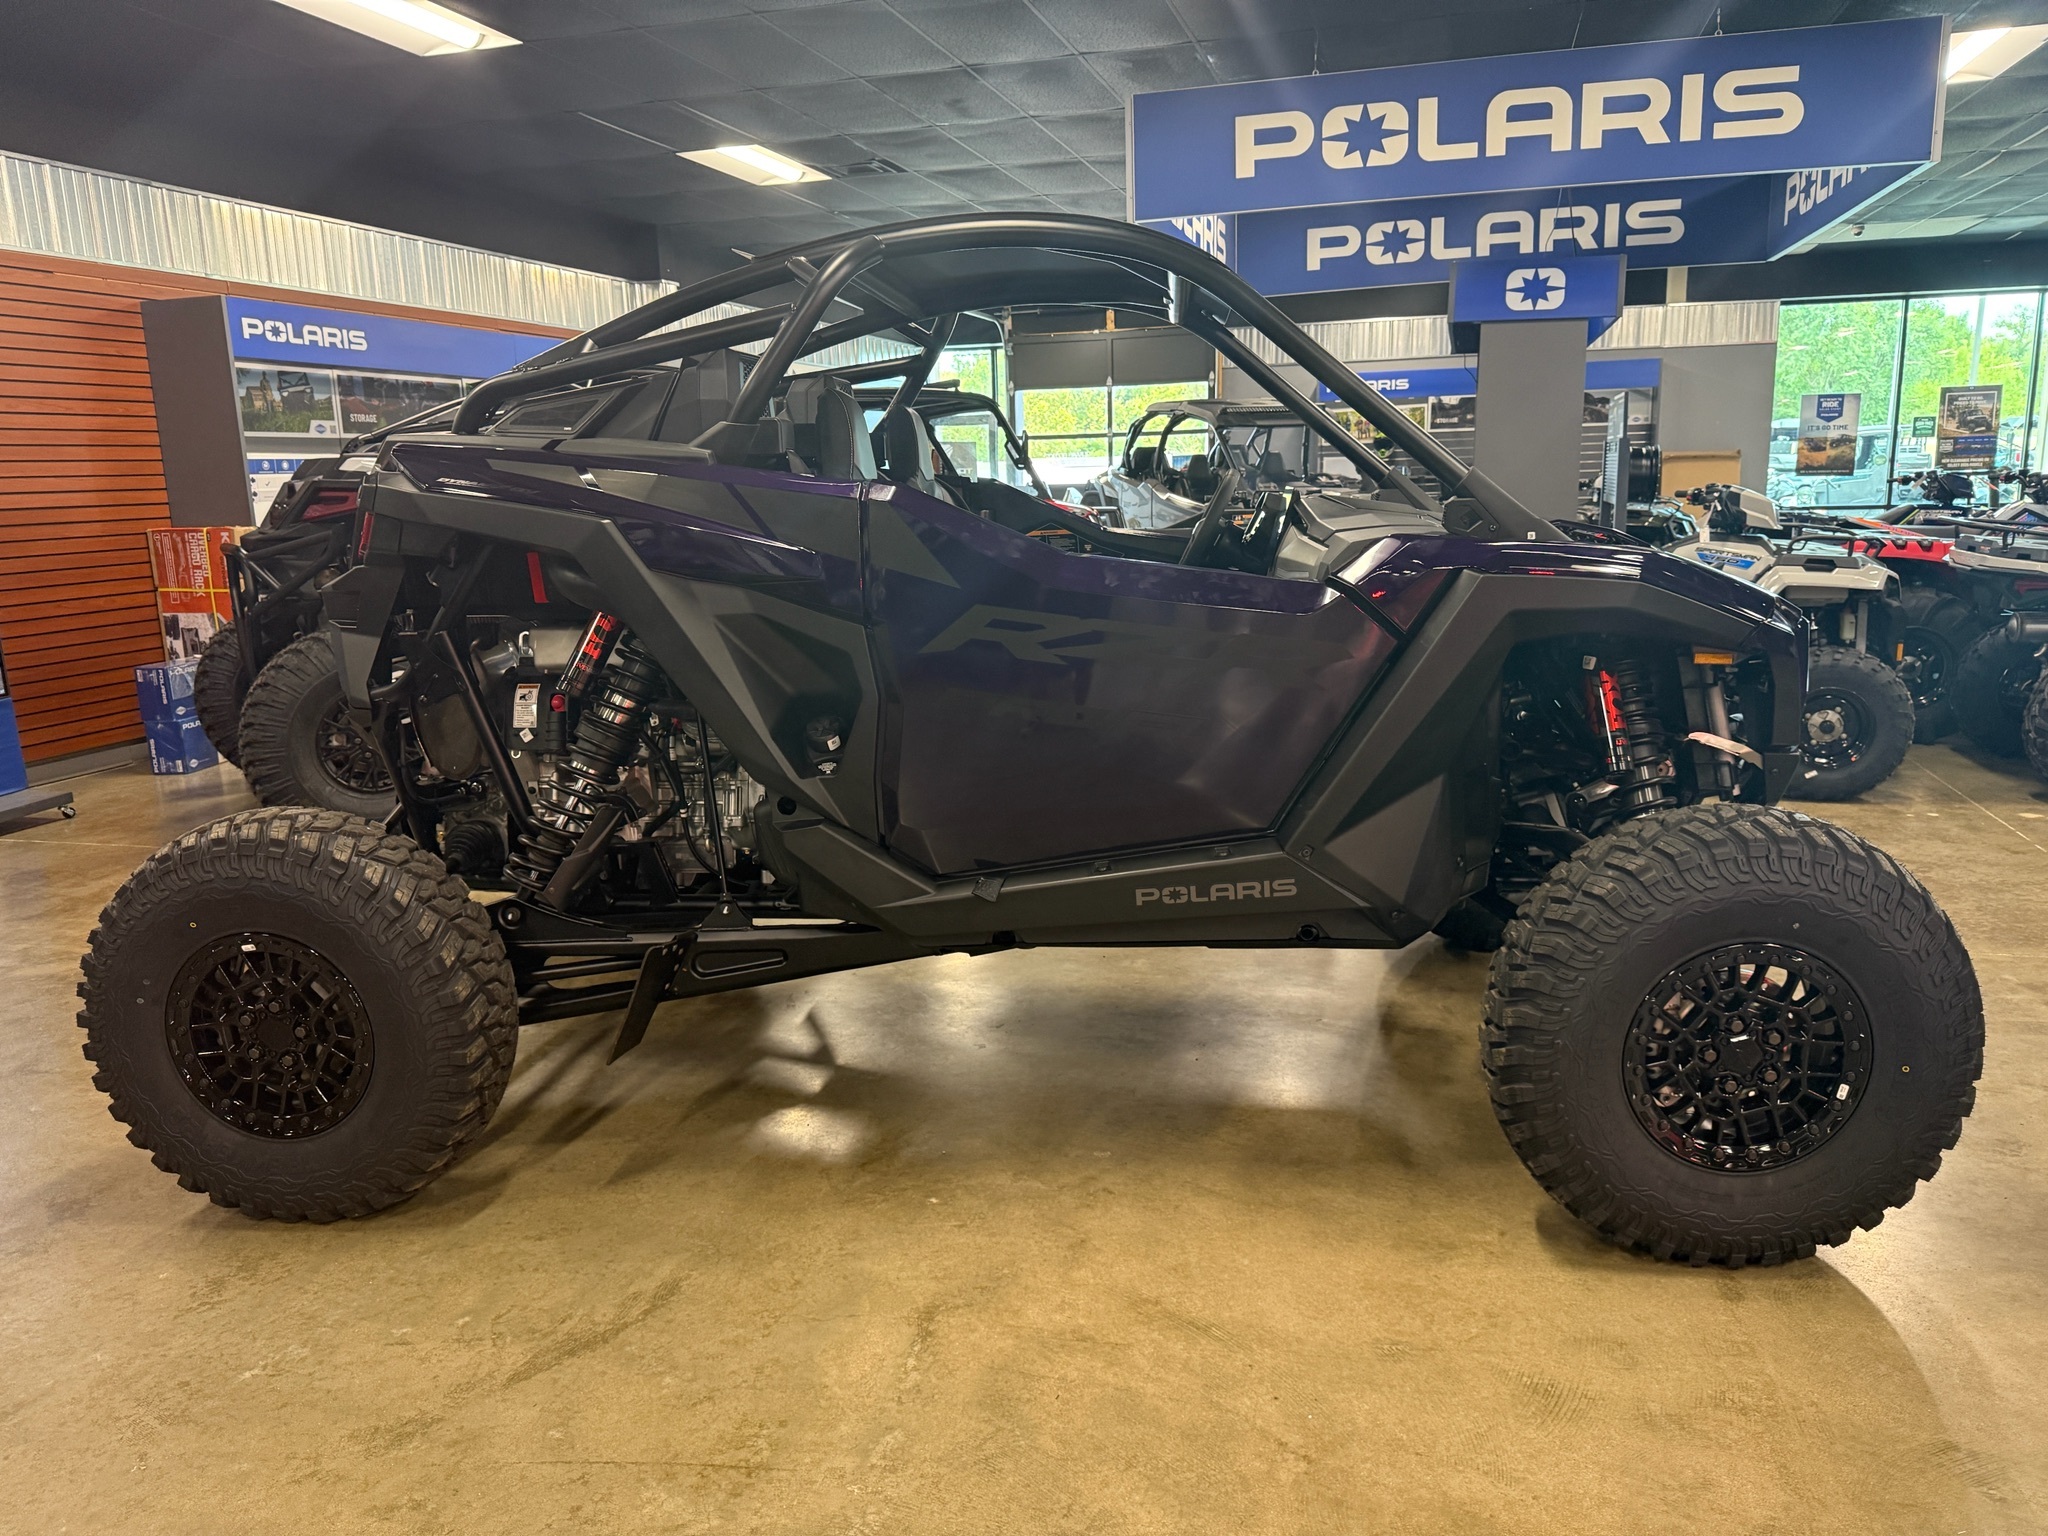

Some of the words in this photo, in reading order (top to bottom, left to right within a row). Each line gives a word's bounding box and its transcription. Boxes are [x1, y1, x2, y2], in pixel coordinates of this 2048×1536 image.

[1235, 65, 1805, 179] POLARIS
[1306, 198, 1685, 272] POLARIS
[241, 317, 368, 351] POLARIS
[350, 413, 378, 424] STORAGE
[188, 532, 201, 566] CARGO
[194, 570, 206, 597] RACK
[1135, 878, 1298, 906] POLARIS
